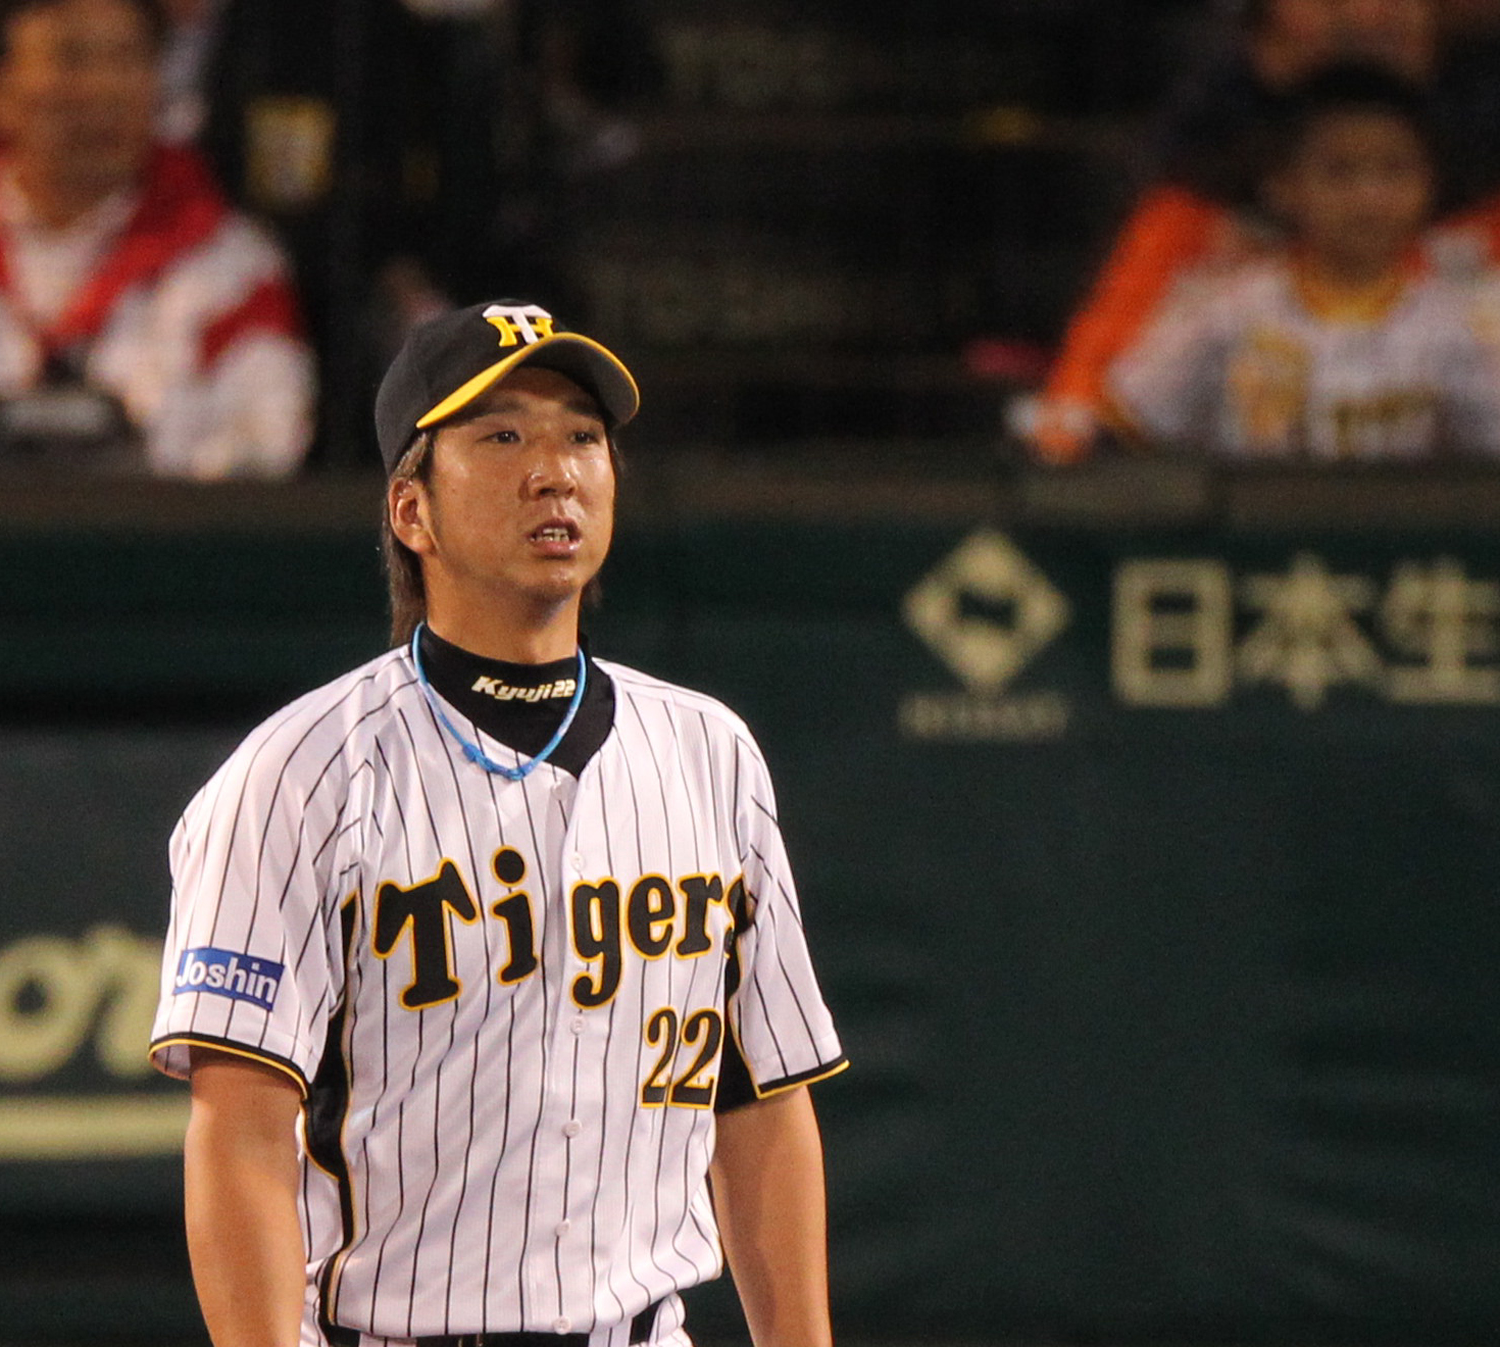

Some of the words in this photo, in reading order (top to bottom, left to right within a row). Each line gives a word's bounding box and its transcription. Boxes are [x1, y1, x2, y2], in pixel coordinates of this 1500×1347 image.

[1110, 552, 1500, 710] 日本生
[175, 951, 278, 1004] Joshin
[639, 1005, 725, 1110] 22
